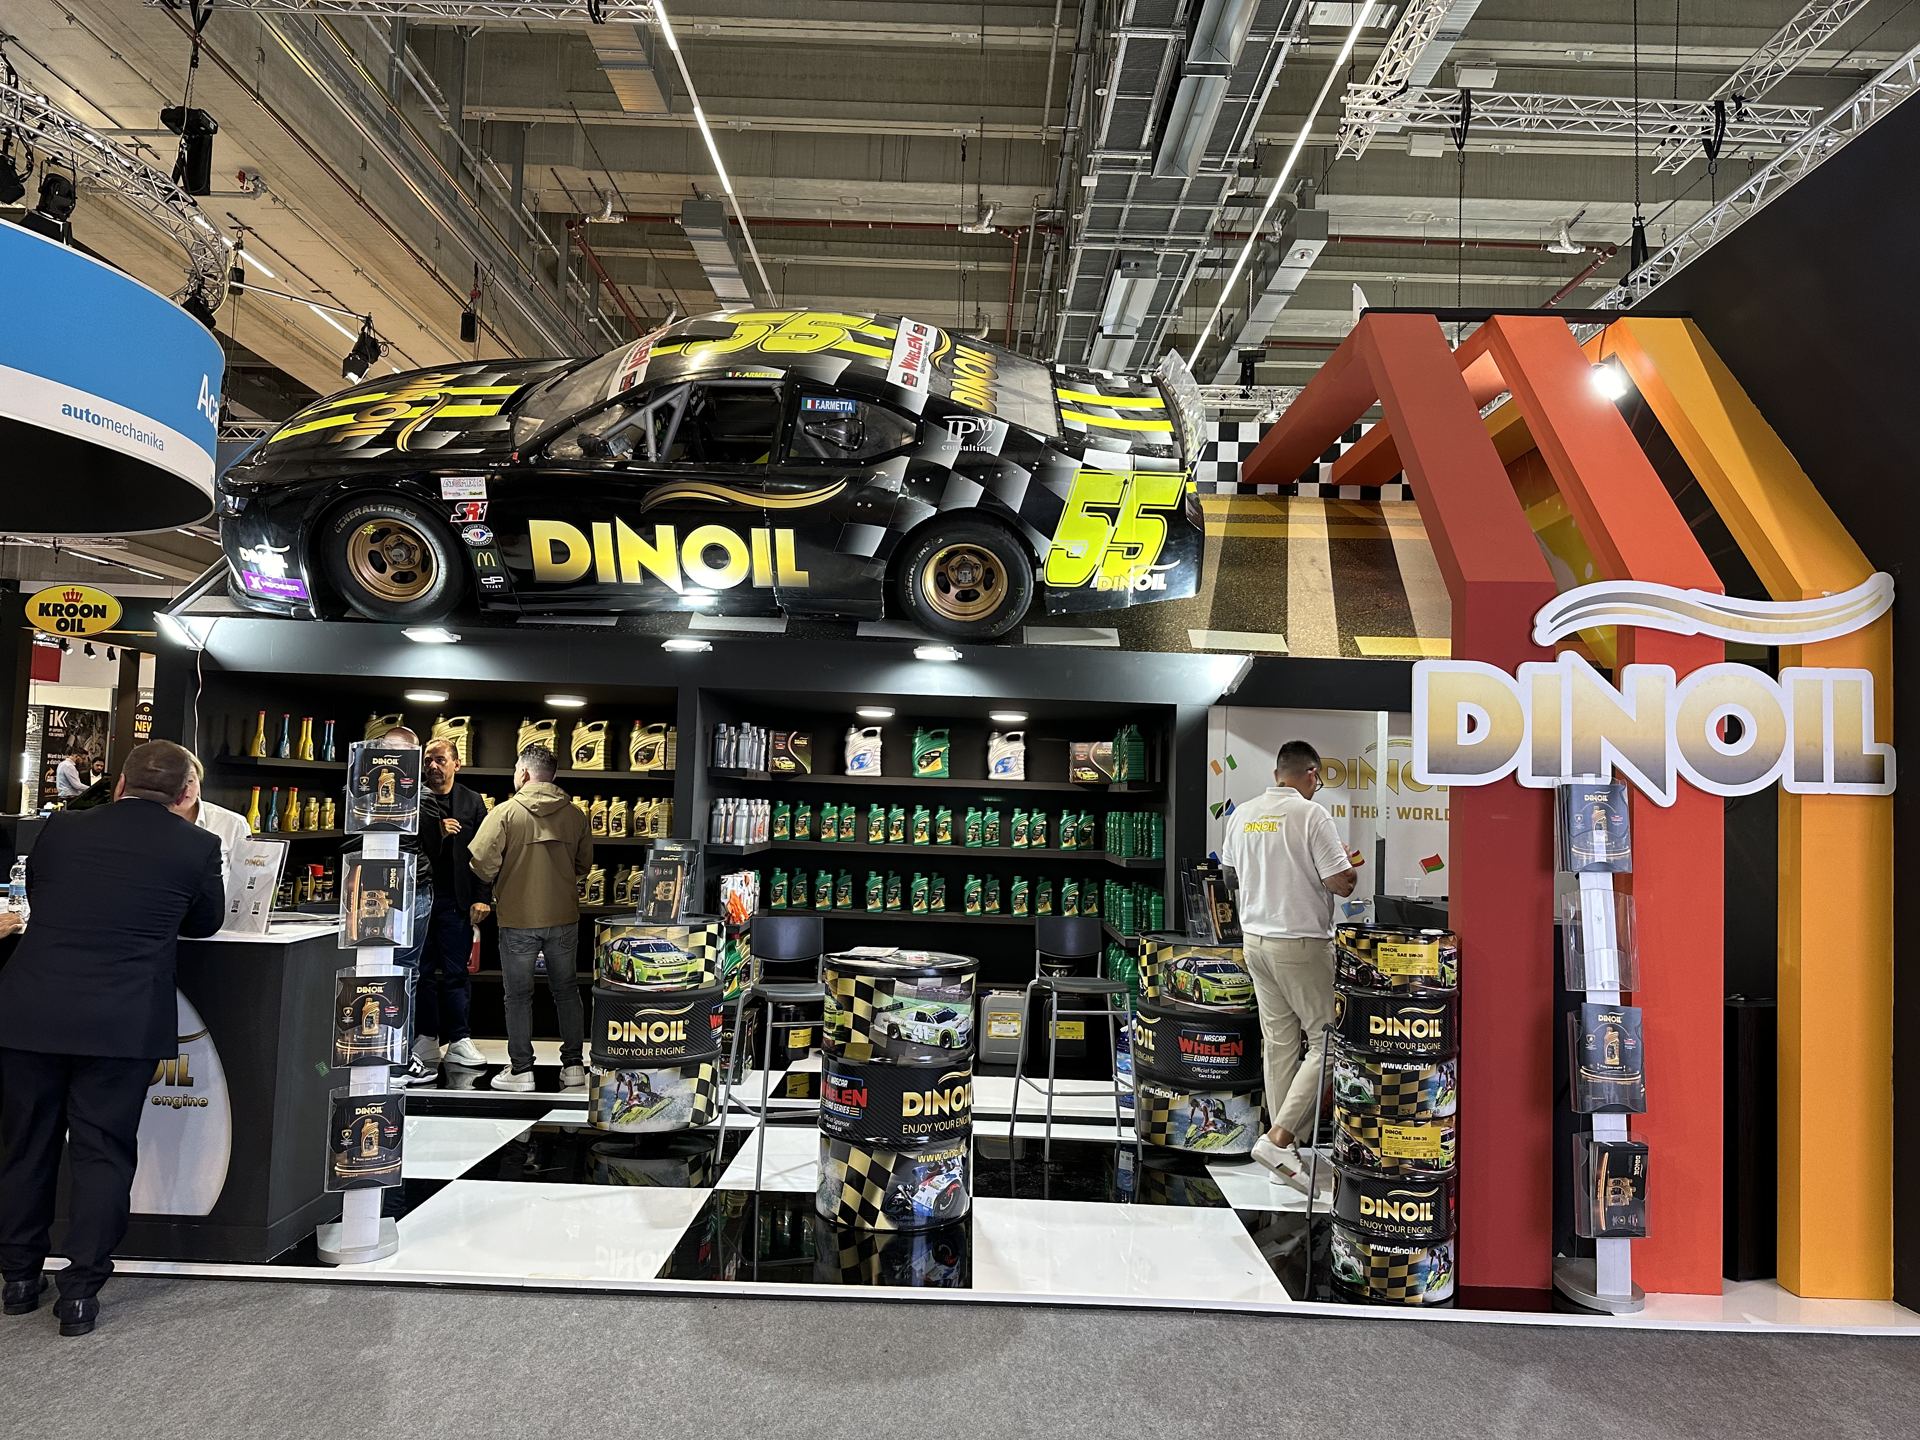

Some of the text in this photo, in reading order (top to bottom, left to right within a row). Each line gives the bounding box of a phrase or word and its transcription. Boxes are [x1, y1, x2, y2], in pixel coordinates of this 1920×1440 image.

[680, 312, 874, 356] 55
[898, 331, 924, 372] WHELEN
[949, 344, 1003, 415] DINOIL
[815, 399, 853, 411] F.ARMETTA
[62, 399, 163, 451] automechanika
[942, 444, 993, 454] consulting
[1044, 469, 1188, 587] 55
[529, 515, 810, 594] DINOIL
[1096, 572, 1168, 593] DINOIL
[38, 602, 107, 618] KROON
[55, 618, 86, 633] OIL
[1420, 656, 1891, 802] DINOIL
[372, 757, 399, 766] DINOIL
[1331, 804, 1346, 817] IN
[1244, 820, 1278, 833] DINOIL
[356, 986, 384, 994] DINOIL
[607, 1020, 688, 1044] DINOIL
[1369, 1016, 1442, 1040] DINOIL
[1203, 1034, 1227, 1042] NASCAR
[1369, 1039, 1441, 1051] ENJOY YOUR ENGINE
[607, 1045, 686, 1057] ENJOY YOUR ENGINE
[1177, 1036, 1243, 1056] WHELEN
[1193, 1055, 1229, 1064] EURO SERIES
[1380, 1061, 1432, 1071] www.dinoil.fr
[151, 1093, 208, 1110] engine
[834, 1103, 850, 1115] SERIES
[355, 1107, 383, 1115] DINOIL
[902, 1123, 932, 1134] ENJOY
[934, 1119, 955, 1131] YOUR
[1360, 1195, 1434, 1223] DINOIL
[1359, 1218, 1433, 1234] ENJOY YOUR ENGINE
[1369, 1242, 1422, 1255] www.dinoil.fr
